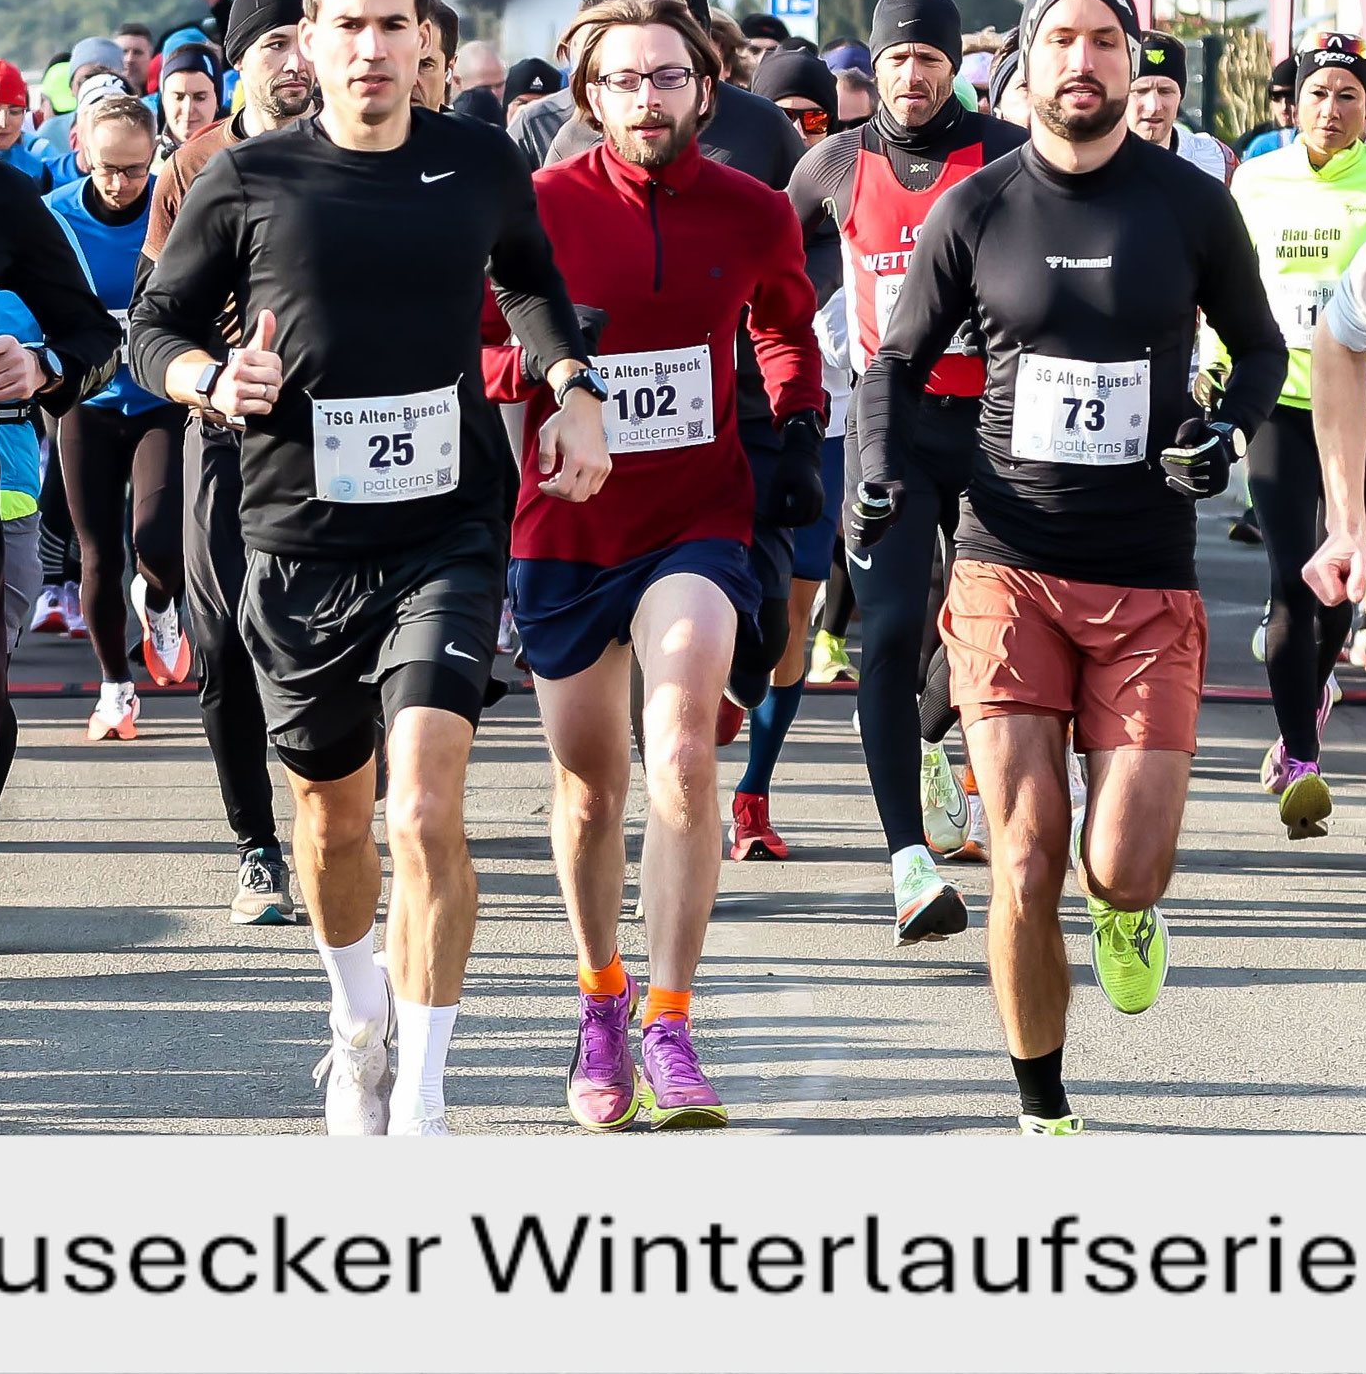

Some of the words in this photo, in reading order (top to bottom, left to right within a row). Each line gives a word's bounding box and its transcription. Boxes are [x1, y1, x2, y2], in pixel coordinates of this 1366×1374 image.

[1062, 255, 1113, 269] hummel
[1276, 245, 1329, 259] Marburg
[614, 357, 701, 380] Alten-Buseck
[1056, 371, 1142, 388] Alten-Buseck
[324, 411, 354, 426] TSG
[359, 400, 451, 424] Alten-Buseck
[612, 385, 678, 420] 102
[1062, 397, 1106, 432] 73
[619, 425, 685, 444] patterns
[368, 432, 415, 469] 25
[1053, 439, 1122, 454] patterns
[363, 473, 434, 494] patterns
